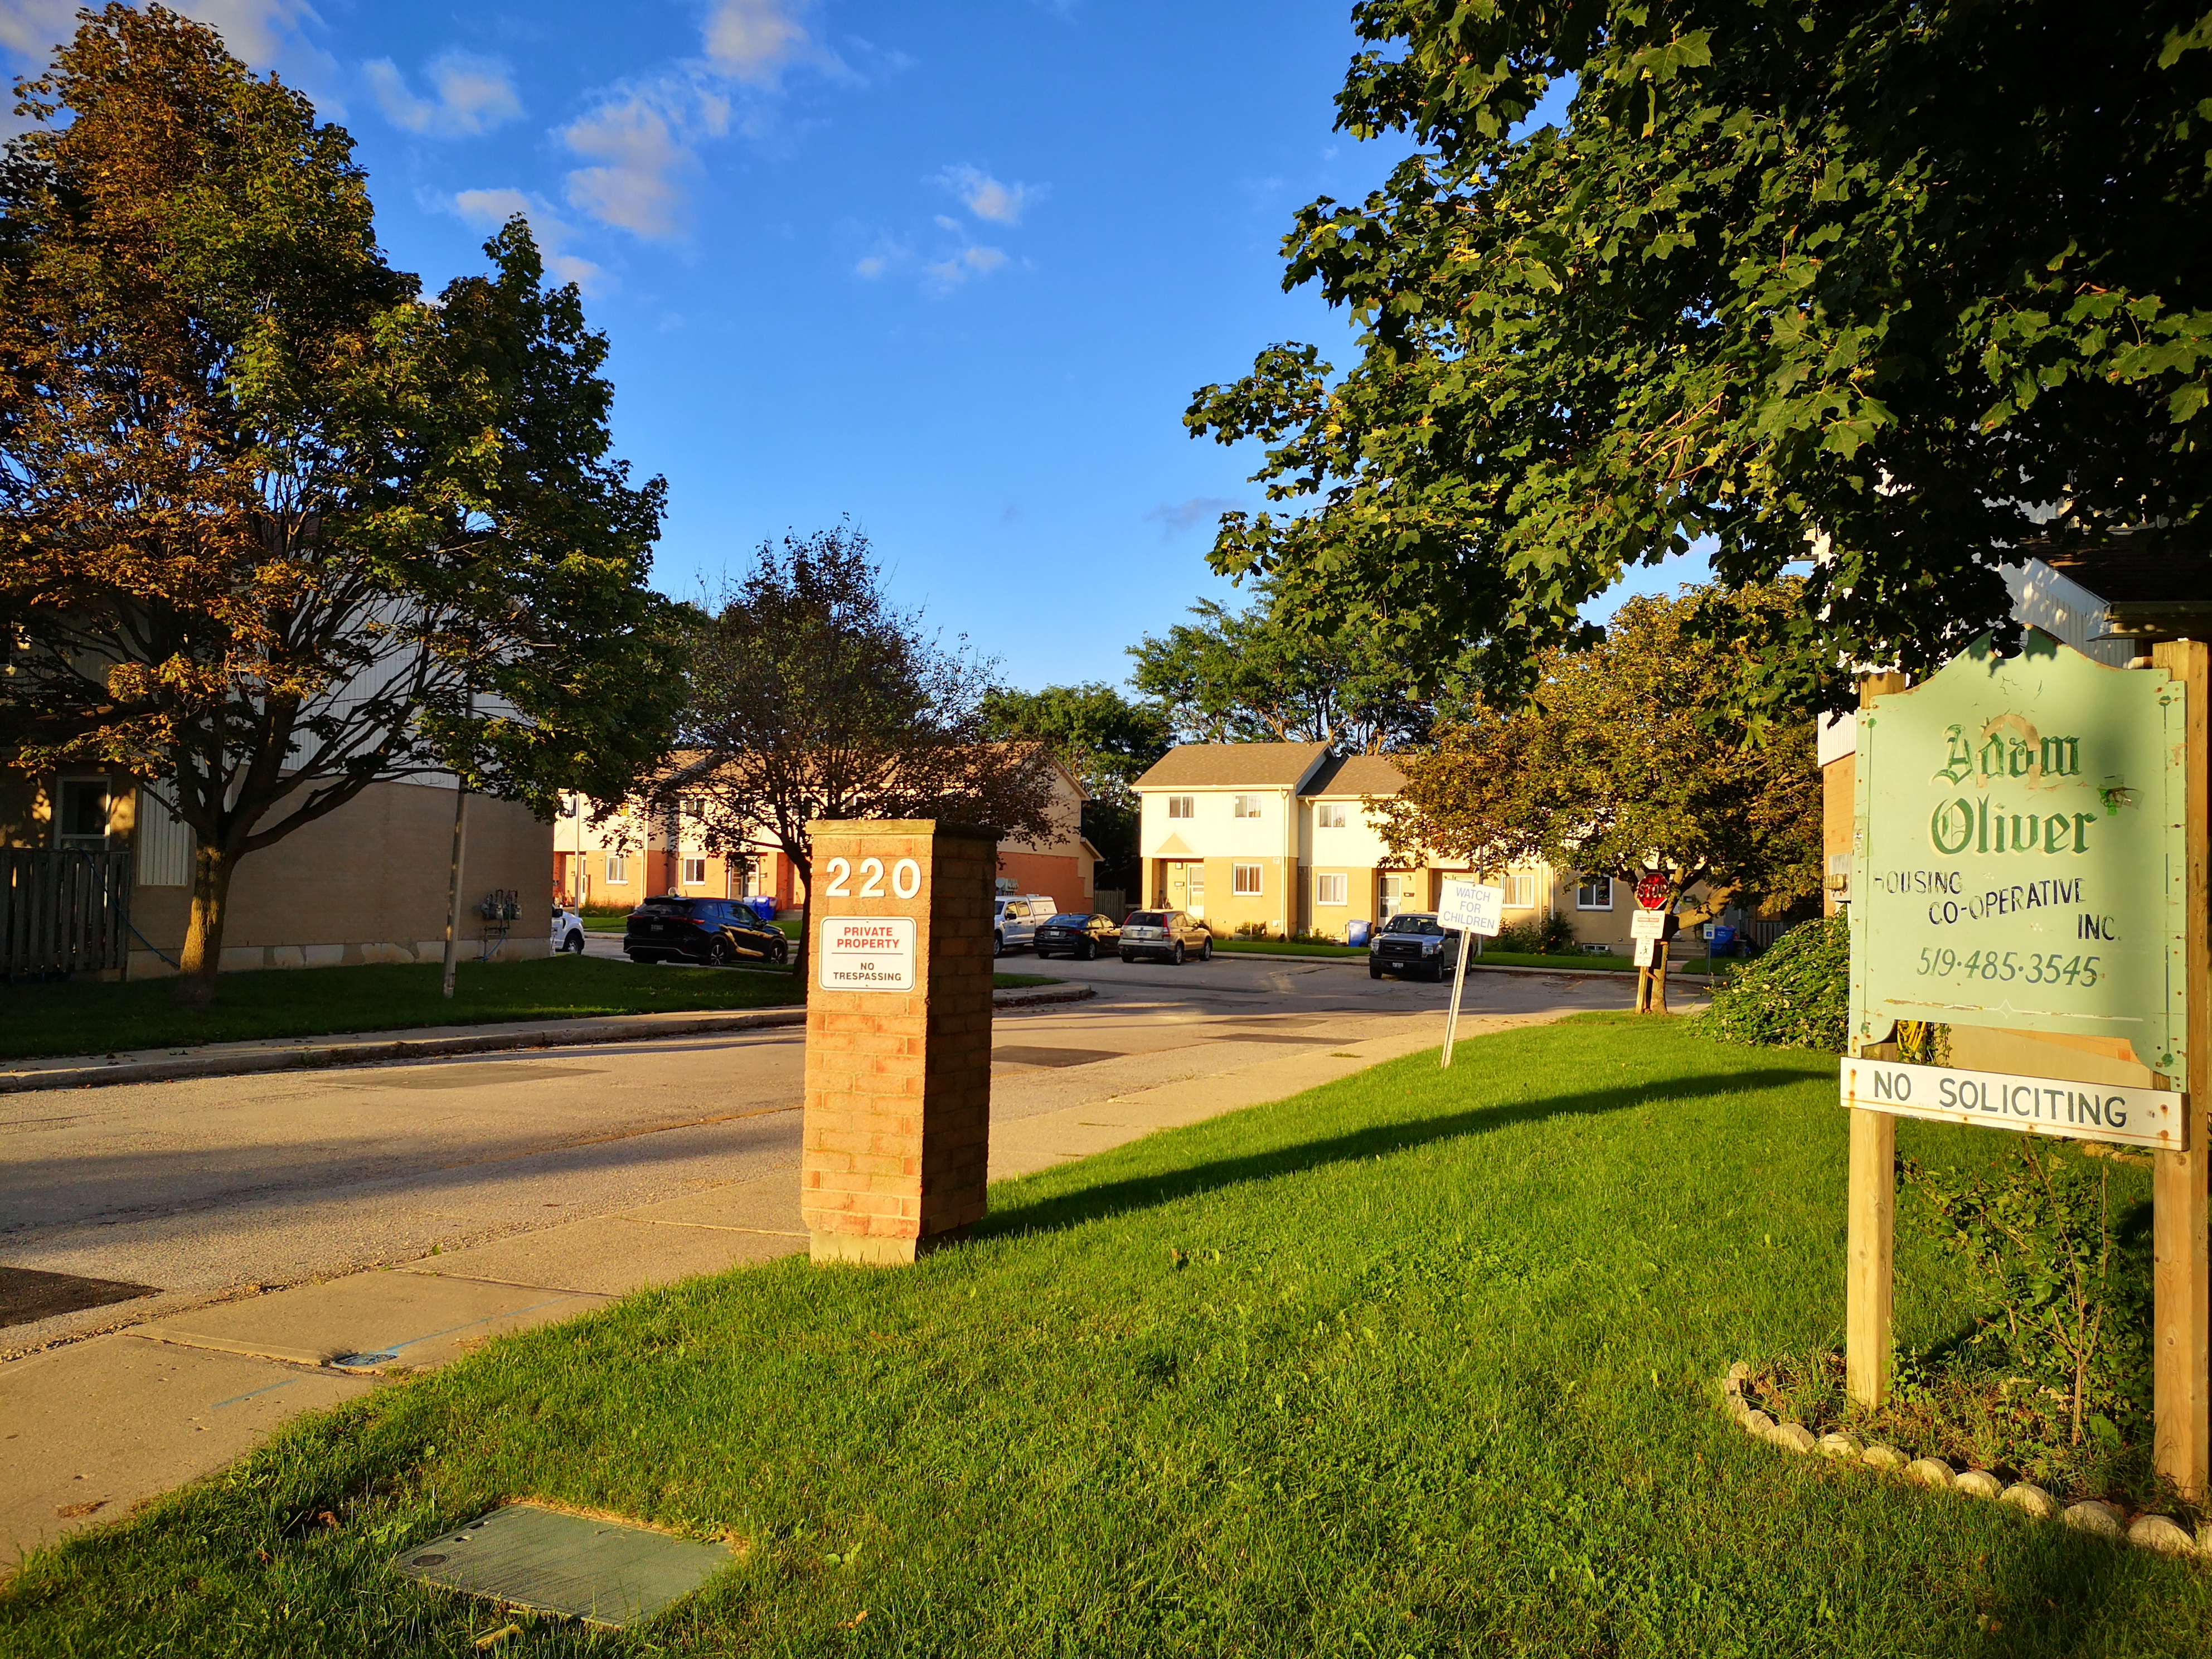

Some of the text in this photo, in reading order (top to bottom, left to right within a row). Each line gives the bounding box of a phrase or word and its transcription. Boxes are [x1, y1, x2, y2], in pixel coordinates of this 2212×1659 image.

[1930, 717, 2082, 787] Adam
[1930, 793, 2098, 856] Oliver
[826, 857, 921, 899] 220
[1456, 886, 1491, 902] WATCH
[1639, 884, 1667, 898] STOP
[1459, 900, 1481, 914] FOR
[1928, 877, 2086, 925] CO-OPERATIVE
[1443, 911, 1495, 929] CHILDREN
[844, 926, 893, 937] PRIVATE
[837, 939, 900, 948] PROPERTY
[860, 962, 875, 971] NO
[833, 972, 901, 981] TRESPASSING
[1874, 1070, 2127, 1128] NO SOLICITING
